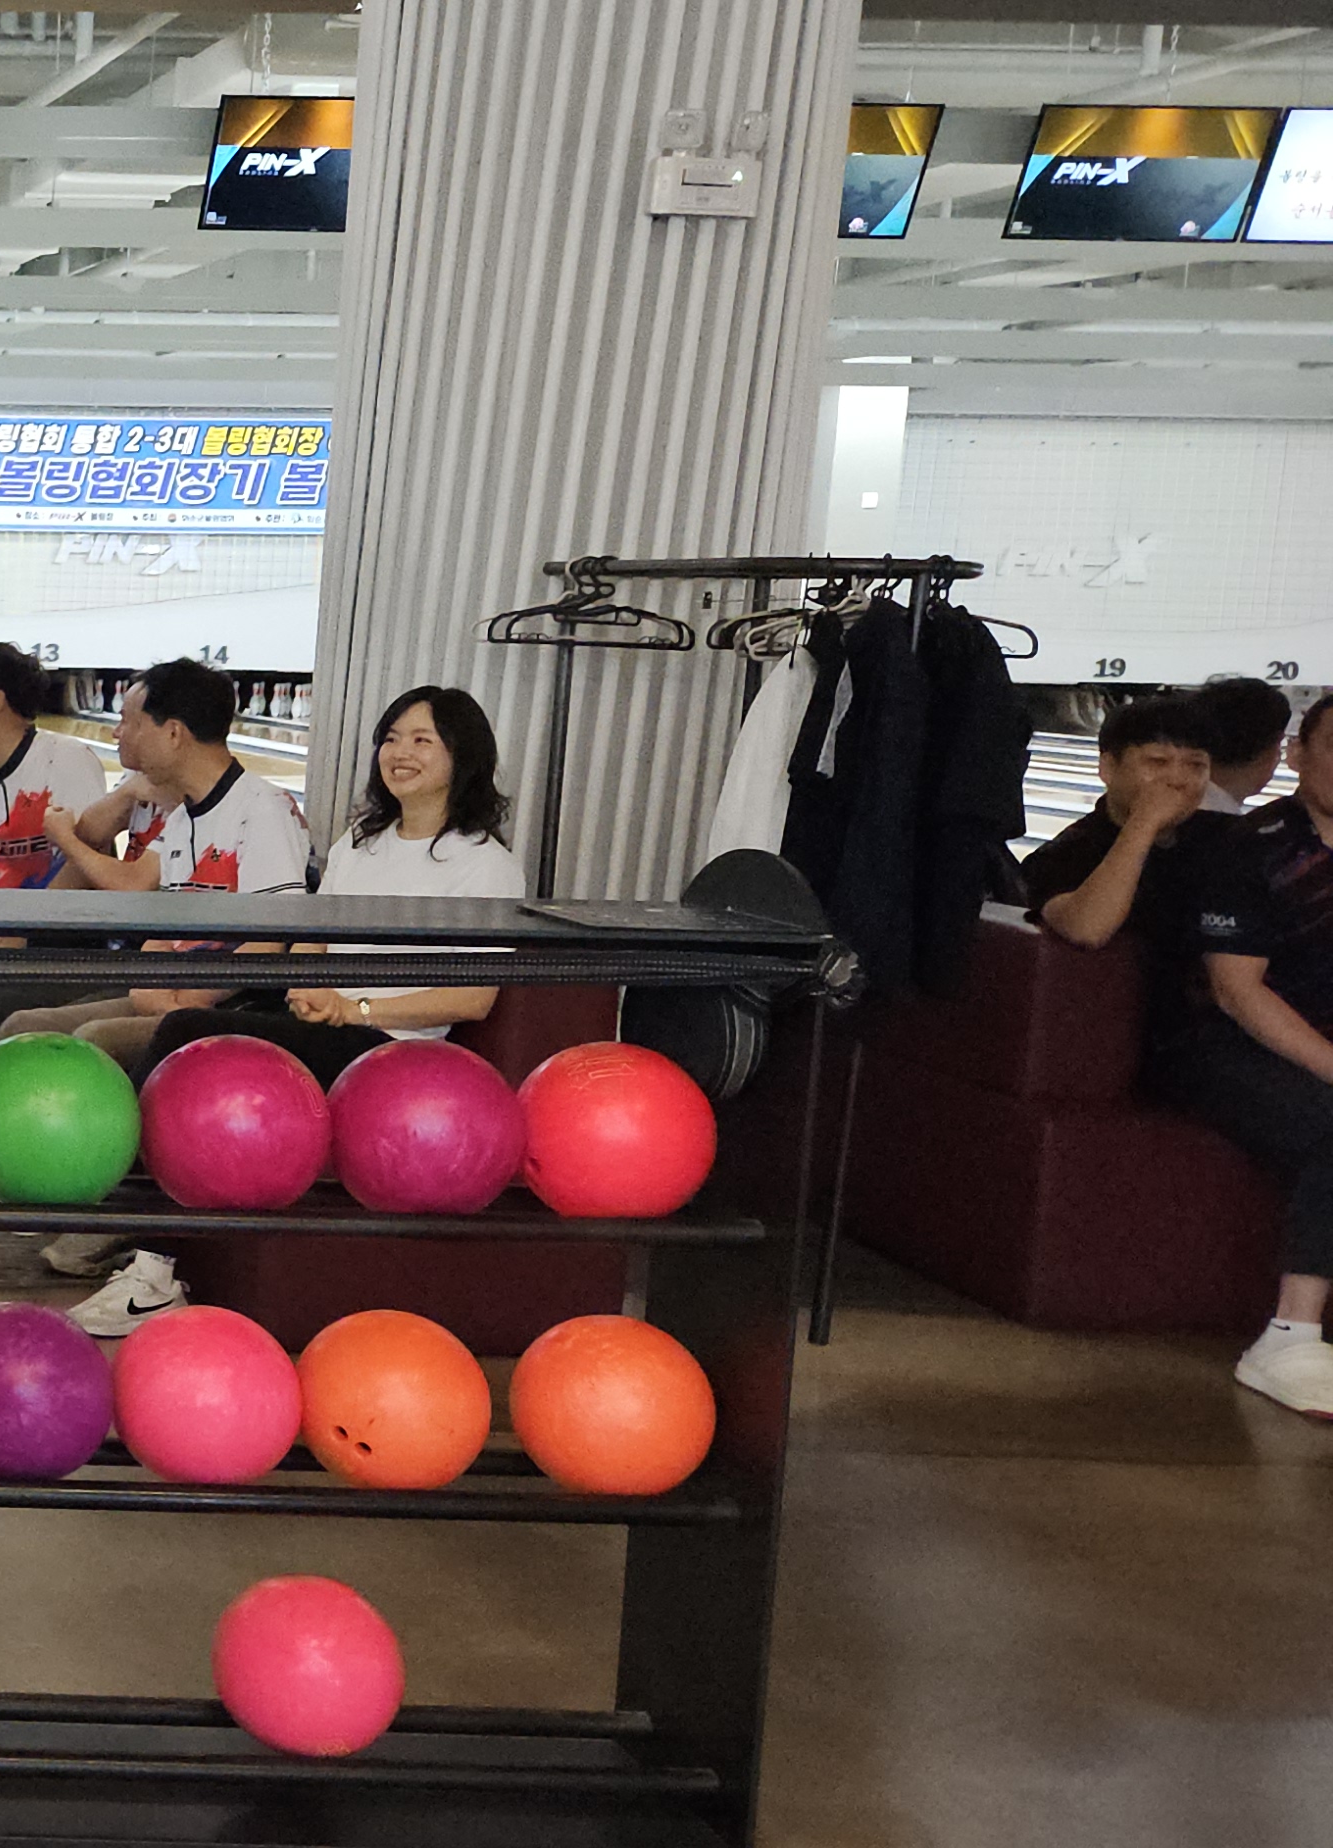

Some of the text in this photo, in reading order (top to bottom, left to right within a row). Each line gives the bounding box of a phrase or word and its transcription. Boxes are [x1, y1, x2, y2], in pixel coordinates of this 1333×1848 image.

[240, 146, 331, 177] PIN-X
[1053, 156, 1147, 186] PIN-X
[71, 424, 122, 455] 통합
[123, 426, 200, 455] 2-3대
[201, 425, 324, 456] 볼링협회장
[31, 643, 60, 662] 13
[200, 645, 230, 665] 14
[1093, 658, 1127, 679] 19
[1266, 660, 1300, 681] 20
